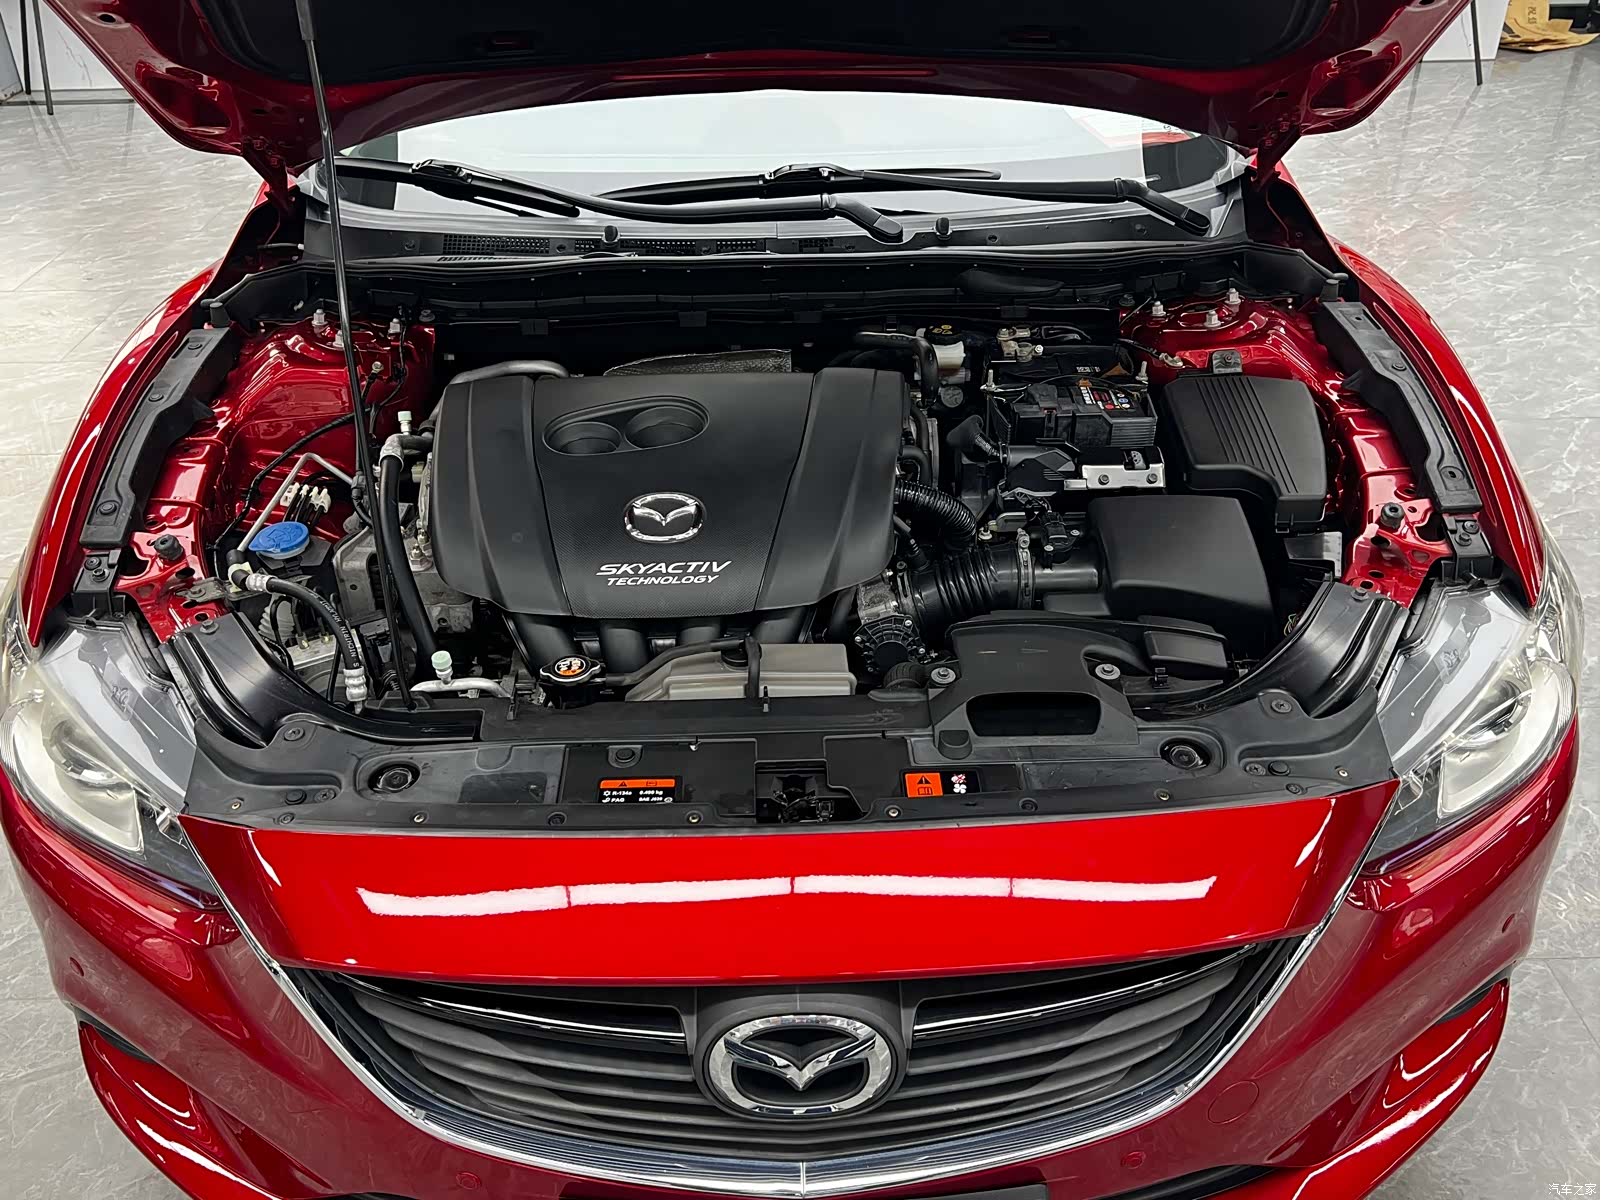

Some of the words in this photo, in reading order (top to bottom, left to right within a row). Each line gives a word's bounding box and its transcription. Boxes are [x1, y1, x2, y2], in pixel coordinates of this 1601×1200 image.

[596, 560, 732, 576] SKYACTIV
[607, 575, 720, 586] TECHNOLOGY
[340, 626, 357, 657] NICHIRIN
